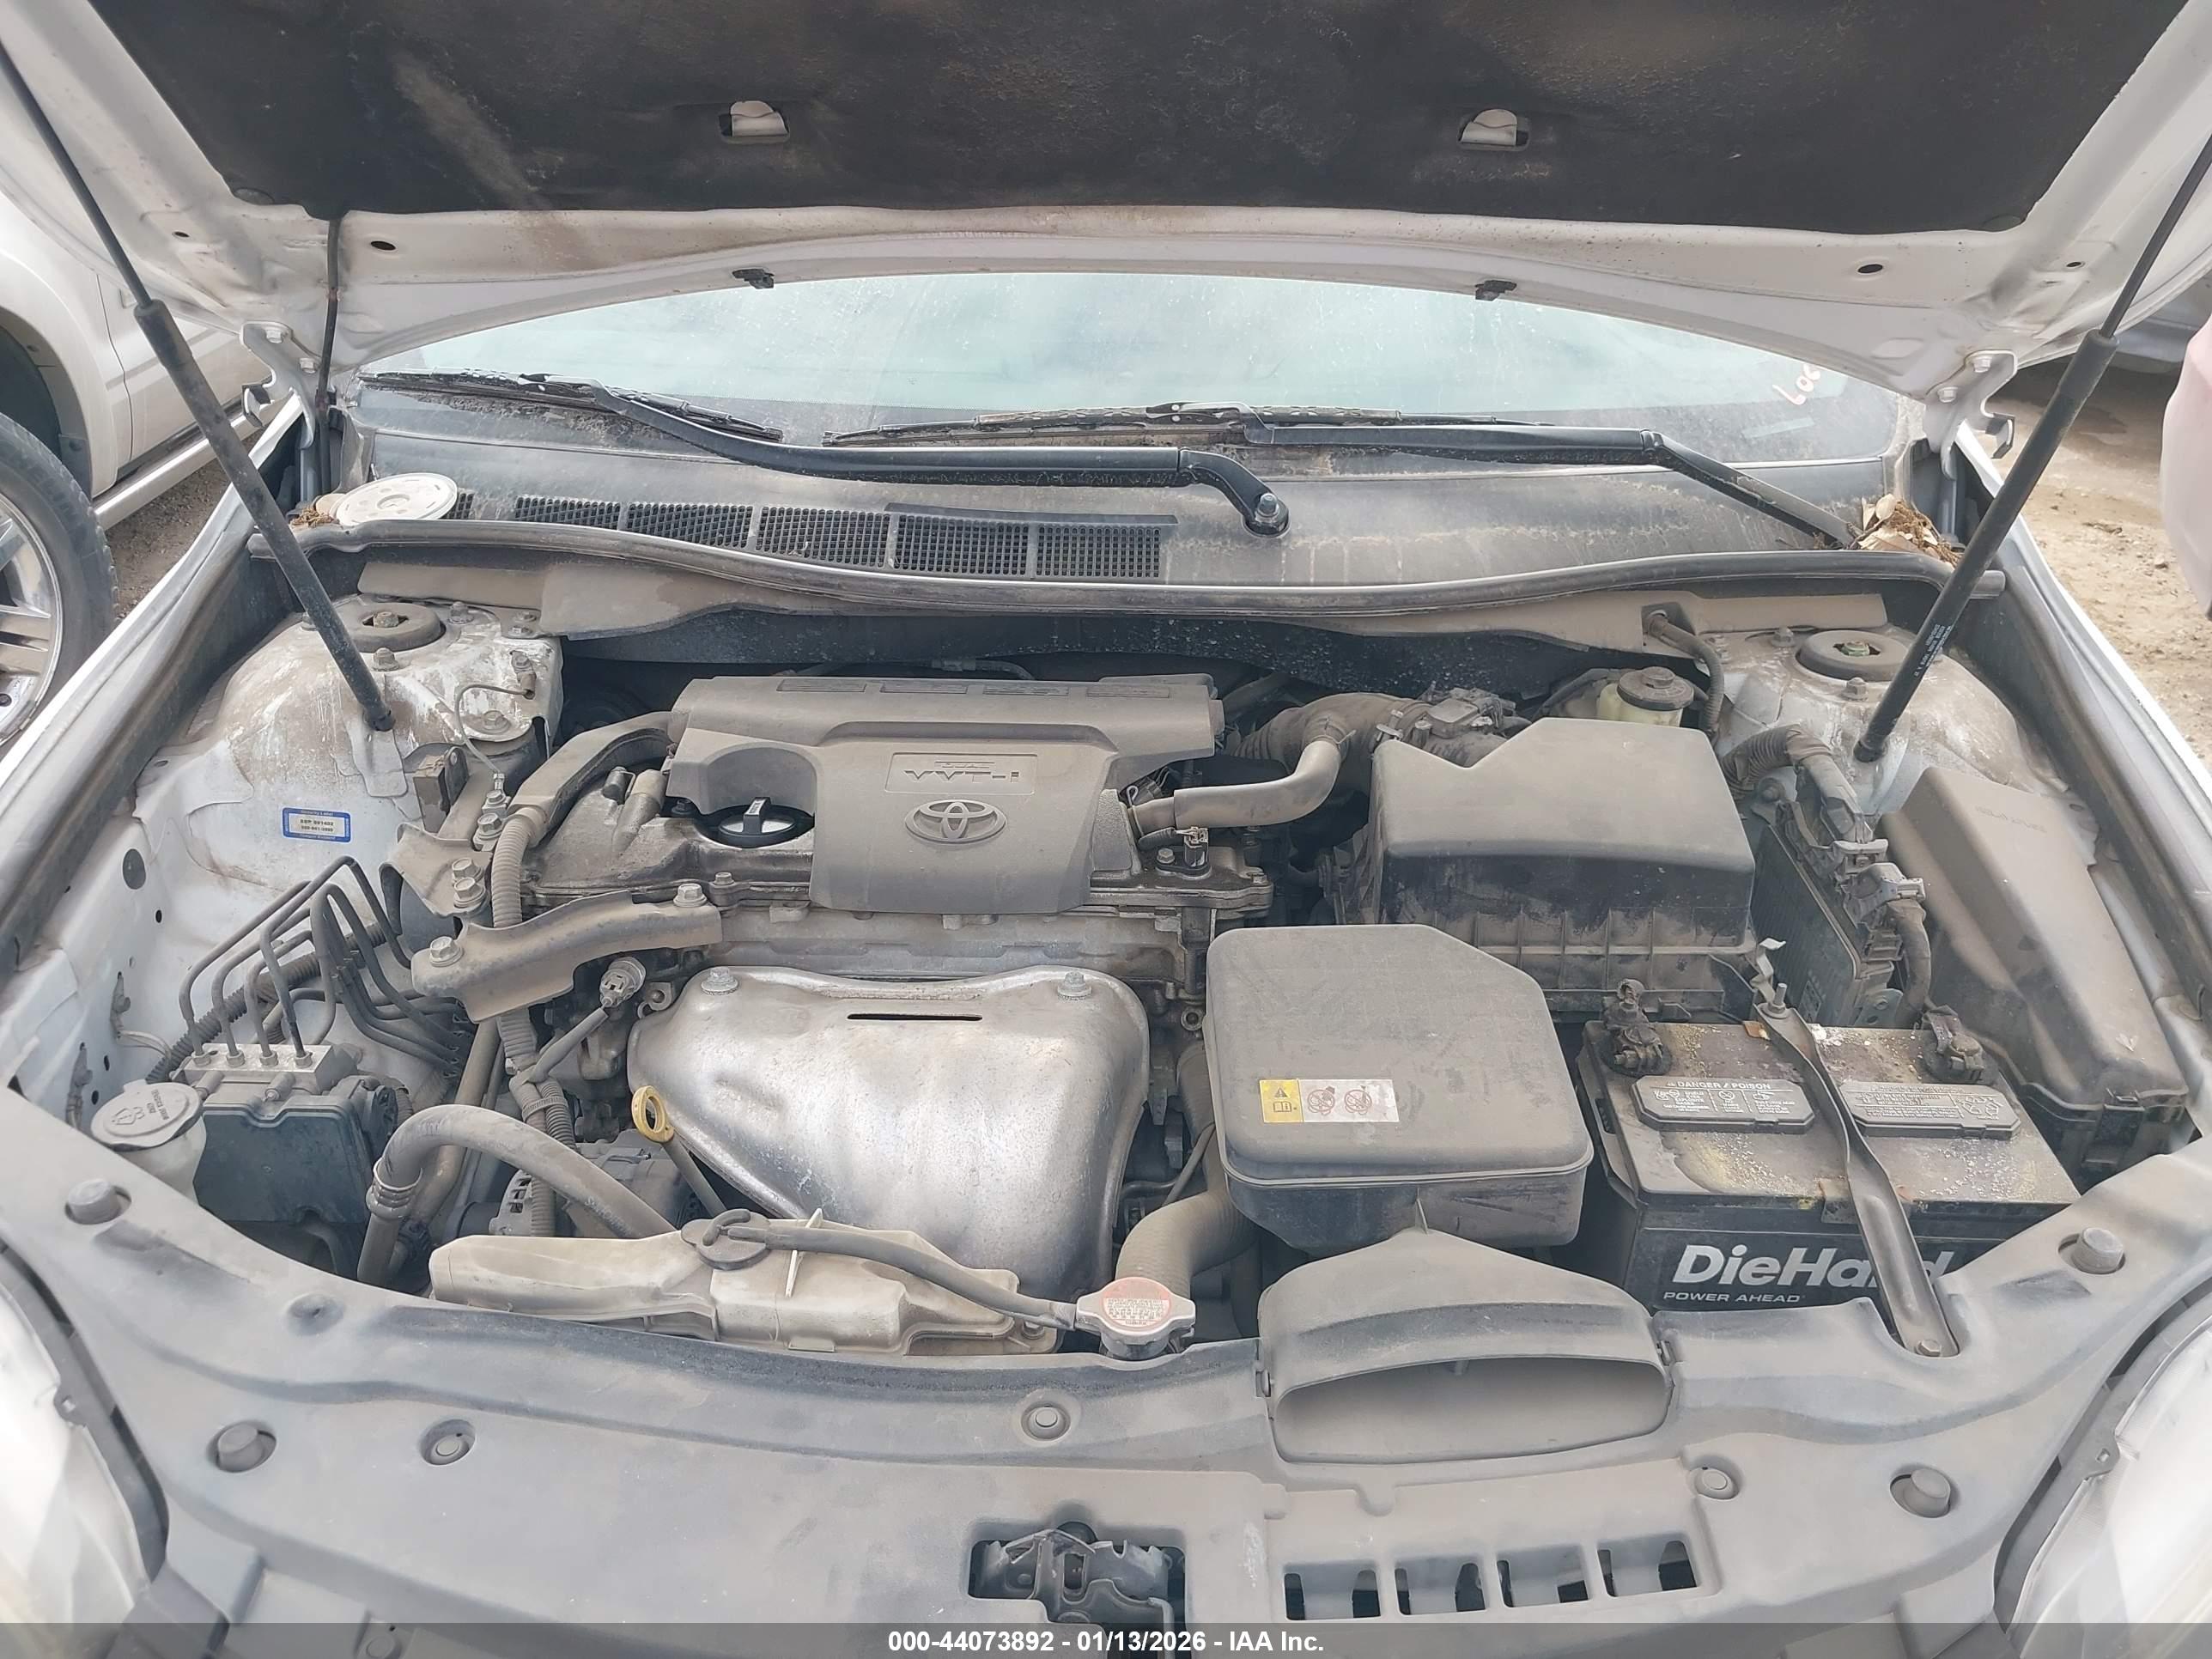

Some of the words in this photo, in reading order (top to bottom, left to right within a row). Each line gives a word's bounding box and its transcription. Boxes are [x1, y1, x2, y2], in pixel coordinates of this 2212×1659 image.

[1672, 1243, 1954, 1288] DieHad
[1663, 1291, 1730, 1303] POWER
[1734, 1293, 1800, 1303] AHEAD
